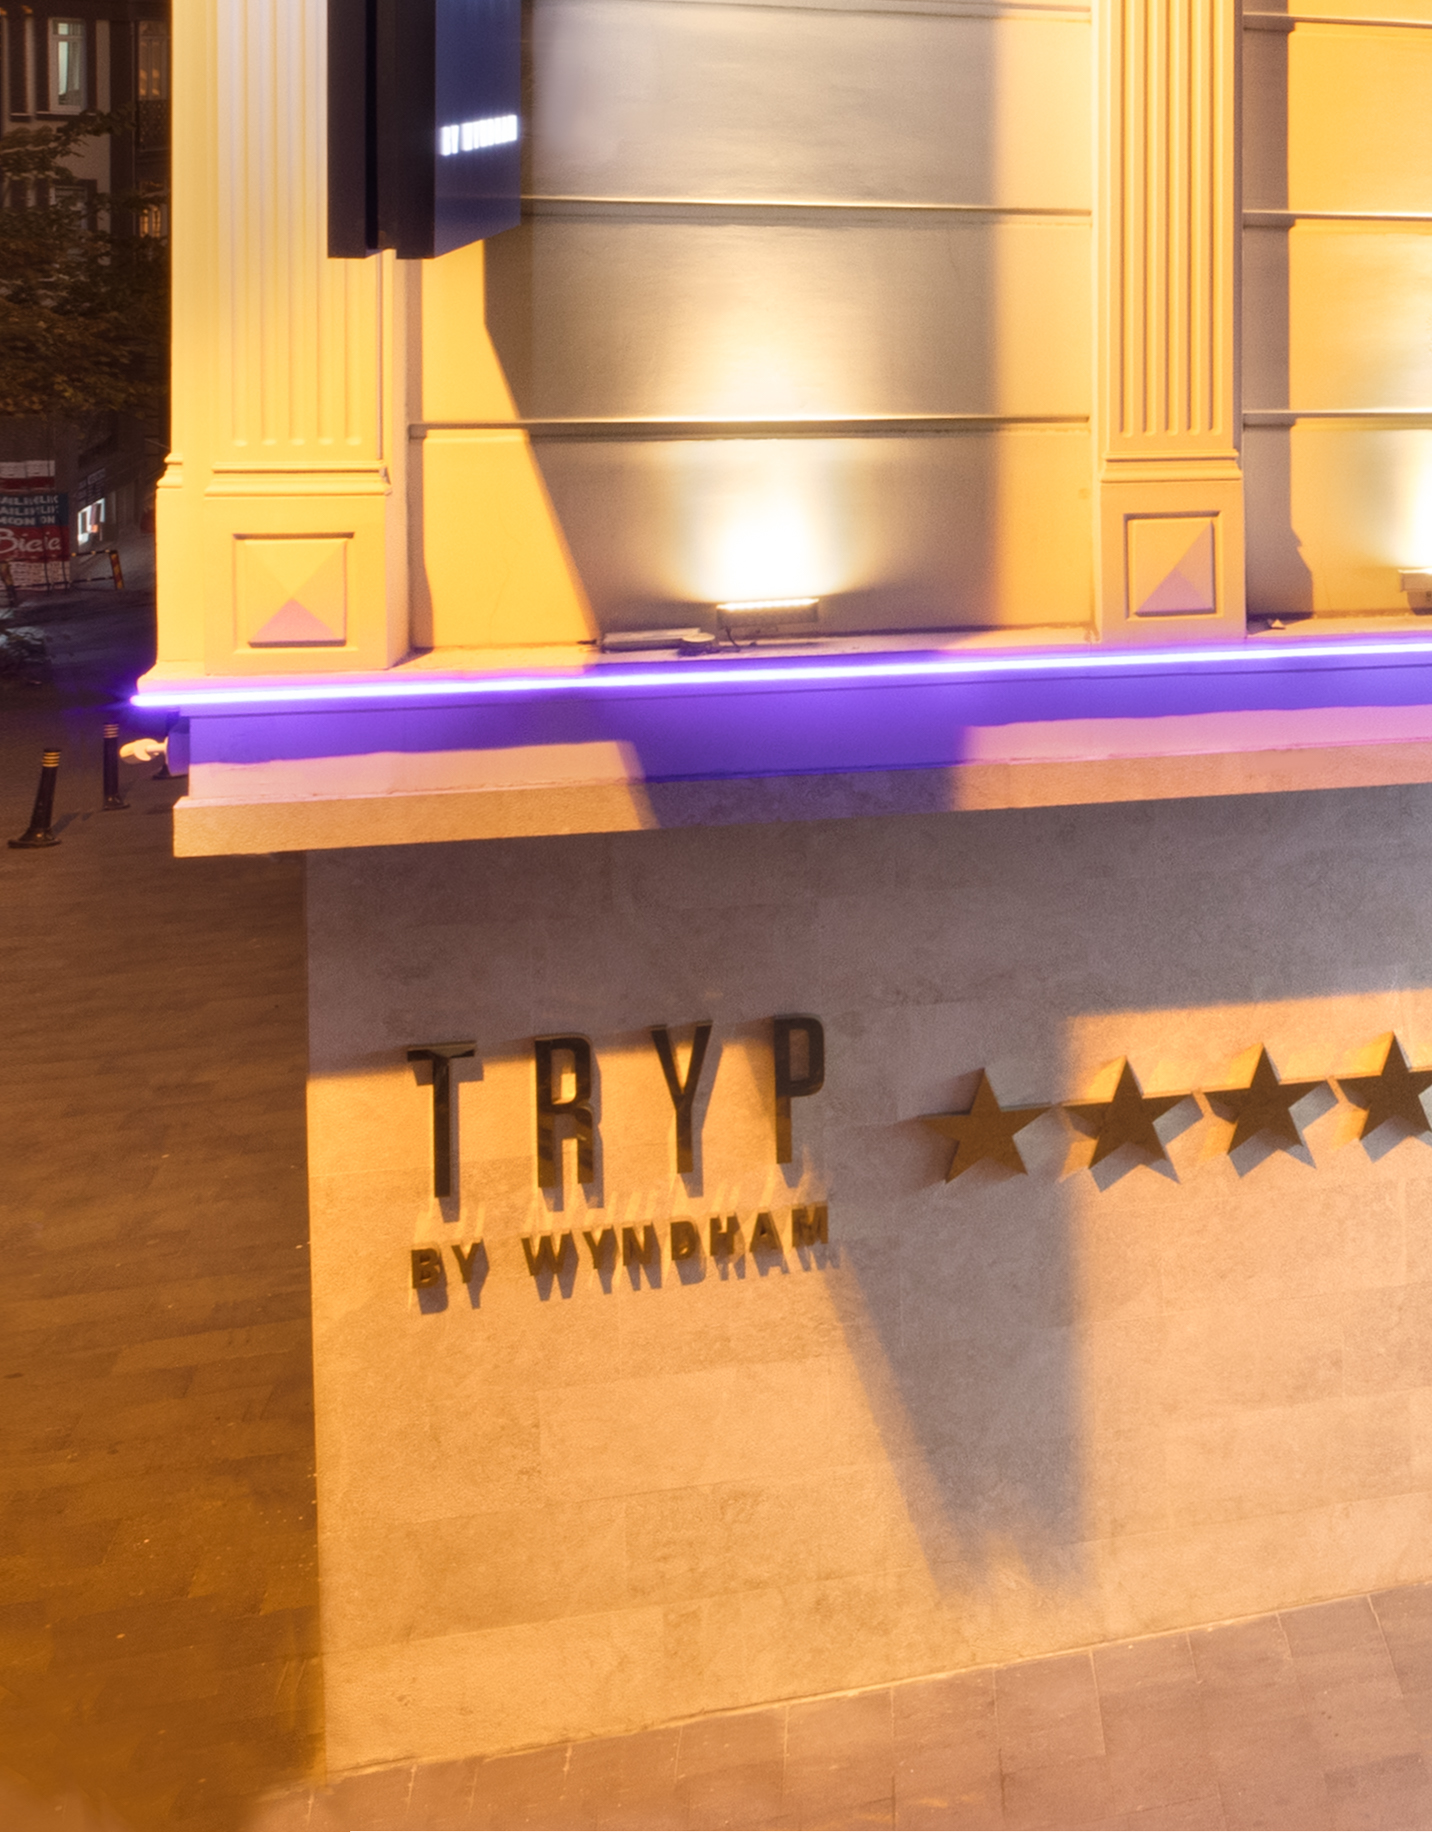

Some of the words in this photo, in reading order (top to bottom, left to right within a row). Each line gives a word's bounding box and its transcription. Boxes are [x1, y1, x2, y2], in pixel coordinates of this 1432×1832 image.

[407, 1013, 826, 1198] TRYP
[410, 1237, 485, 1290] BY
[521, 1202, 830, 1277] WYNDHAM
